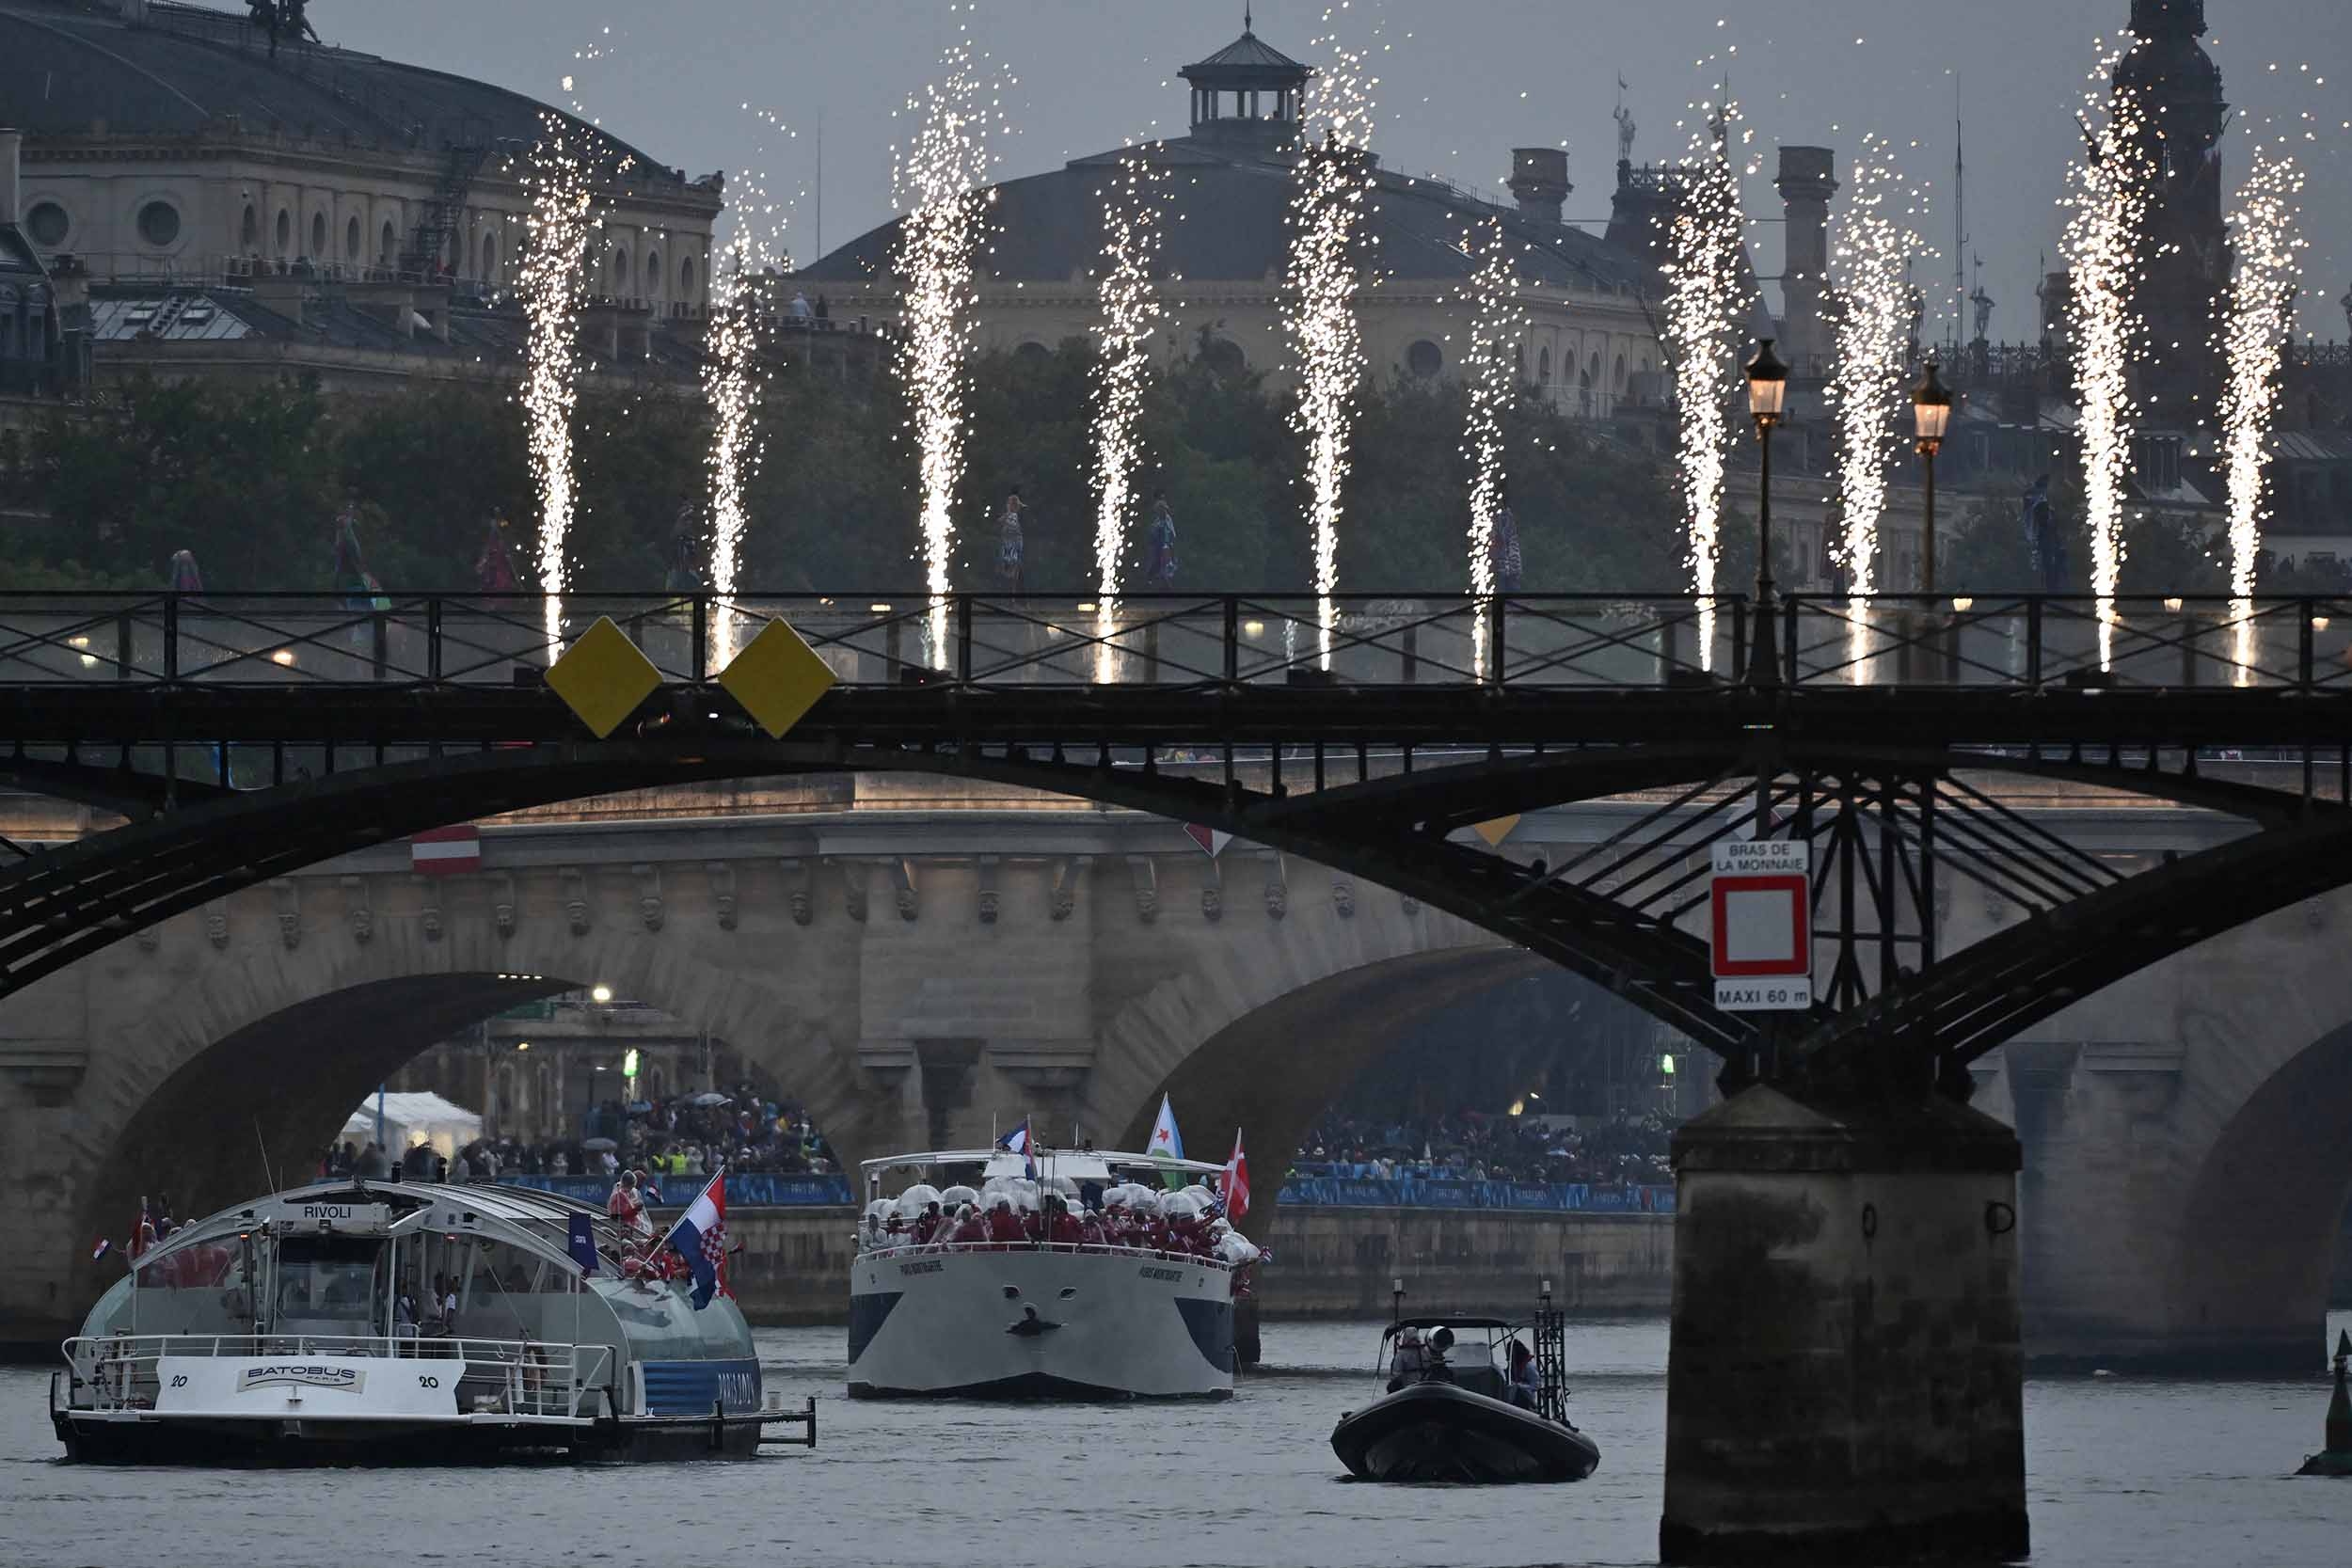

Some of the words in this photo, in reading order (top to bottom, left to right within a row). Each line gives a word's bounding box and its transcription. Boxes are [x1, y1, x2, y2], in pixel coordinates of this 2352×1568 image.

[1729, 845, 1767, 857] BRAS
[1772, 844, 1790, 855] DE
[1717, 861, 1733, 871] LA
[1738, 859, 1804, 871] MONNAIE
[1718, 990, 1760, 1004] MAXI
[1768, 990, 1787, 1003] 60
[1794, 991, 1807, 1002] m
[304, 1206, 351, 1218] RIVOLI
[247, 1366, 356, 1379] BATOBUS
[170, 1374, 187, 1387] 20
[419, 1376, 438, 1388] 20
